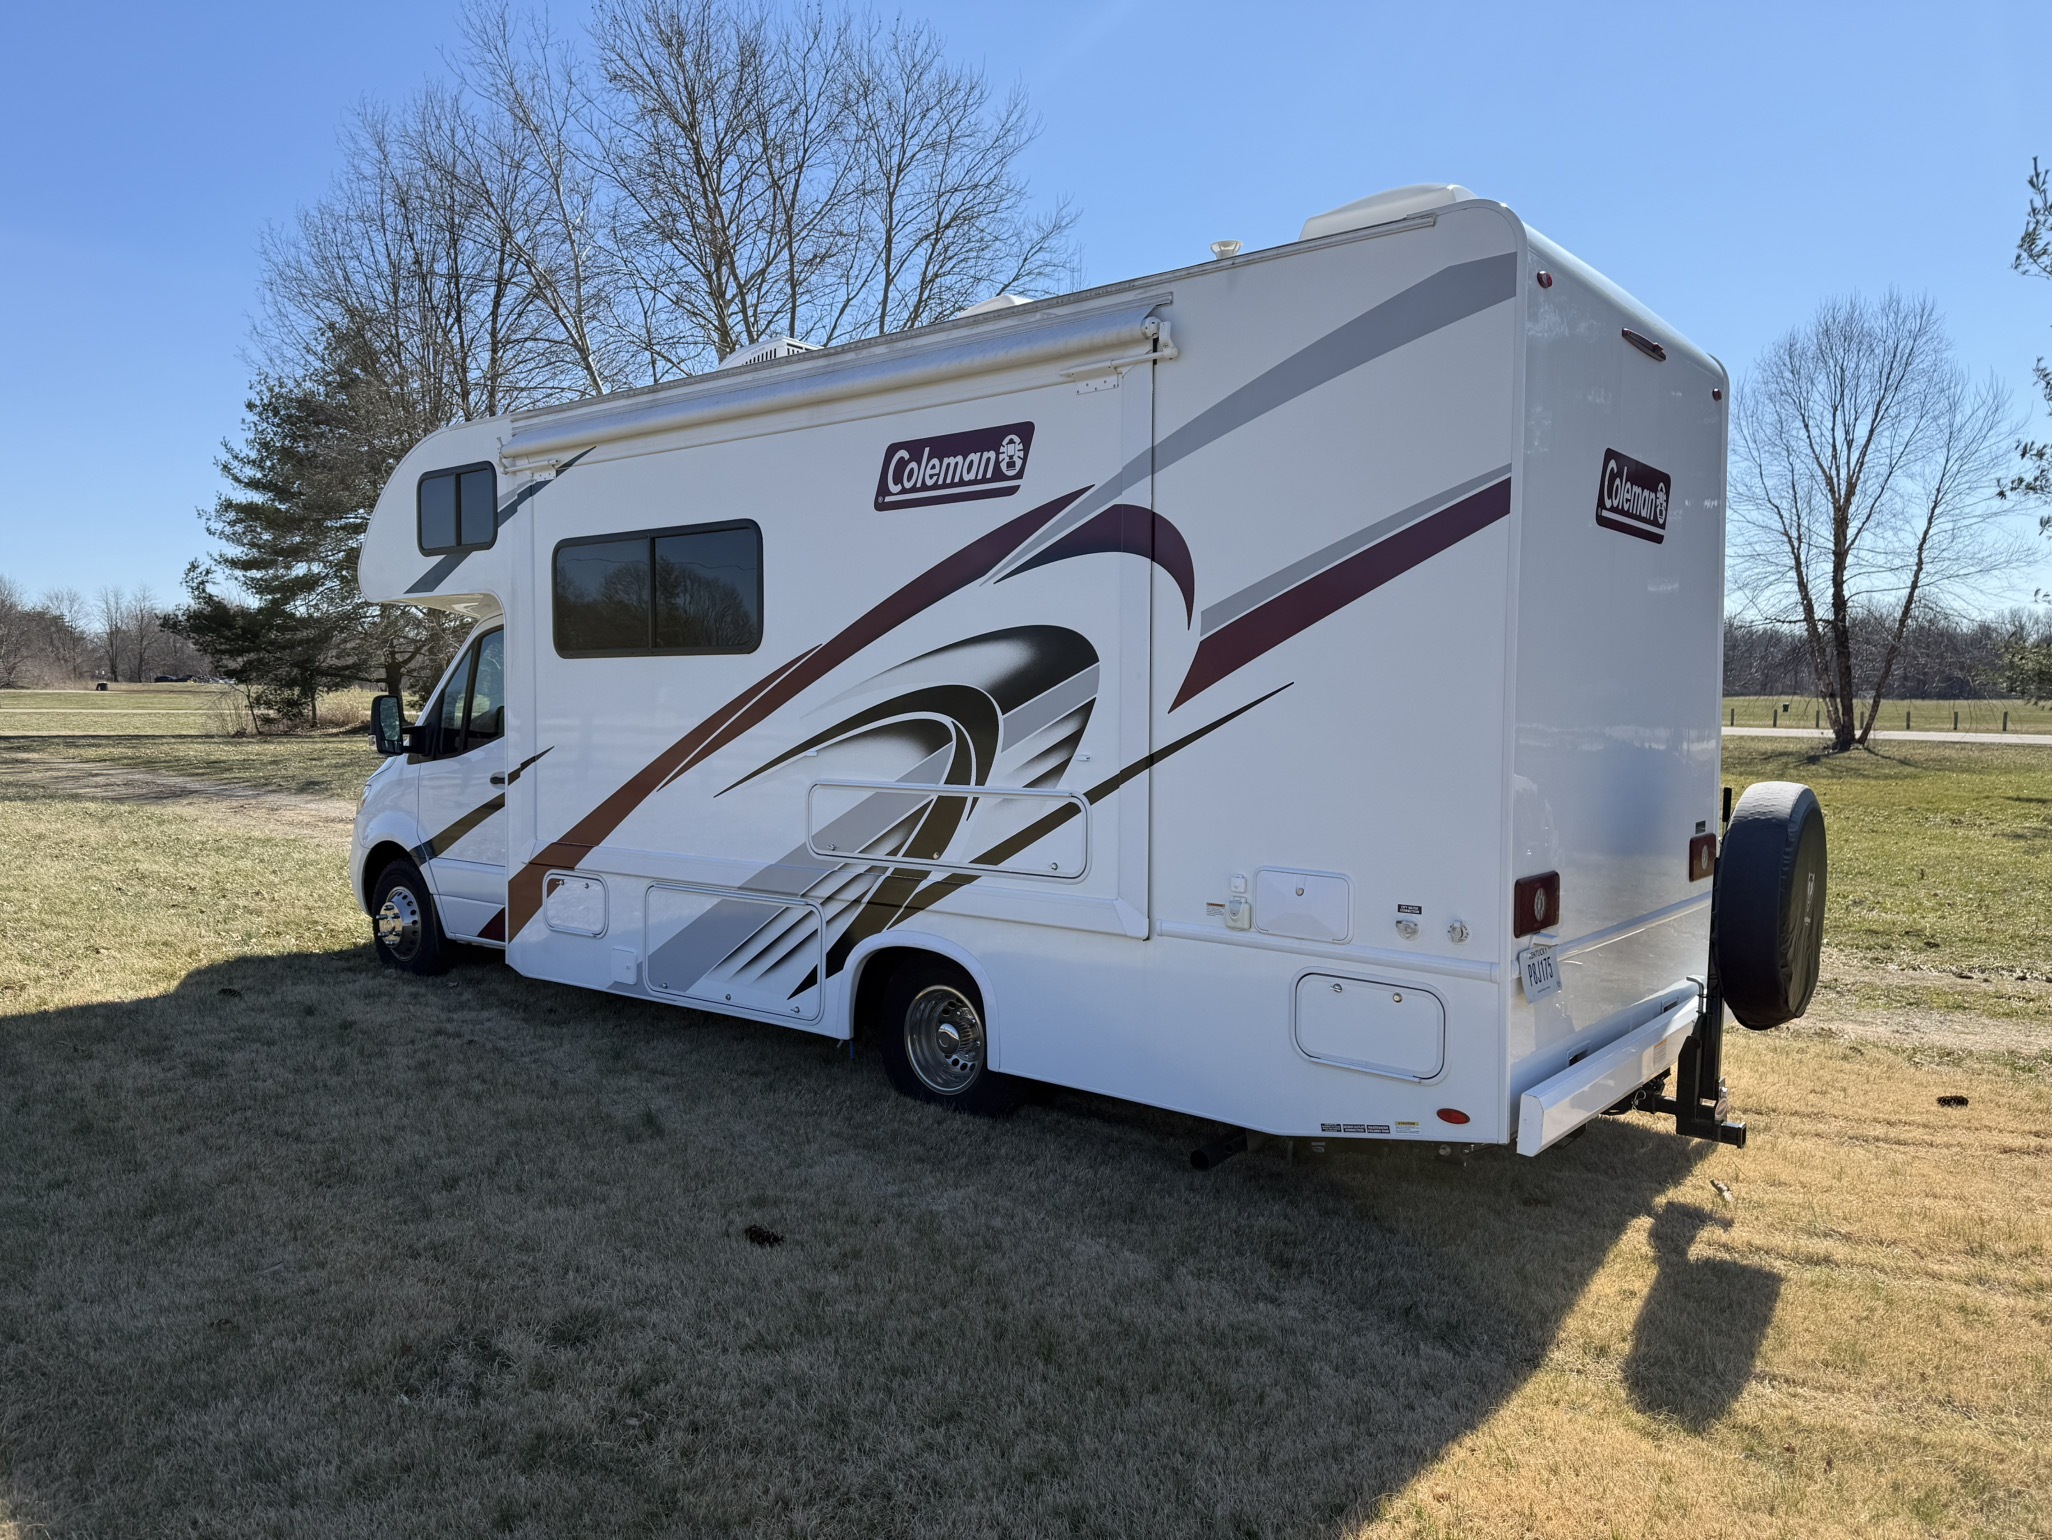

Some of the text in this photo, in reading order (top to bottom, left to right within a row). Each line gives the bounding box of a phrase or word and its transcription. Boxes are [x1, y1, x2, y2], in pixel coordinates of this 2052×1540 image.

[887, 446, 997, 494] Coleman
[1604, 458, 1656, 521] Coleman
[1527, 956, 1554, 987] P8J175
